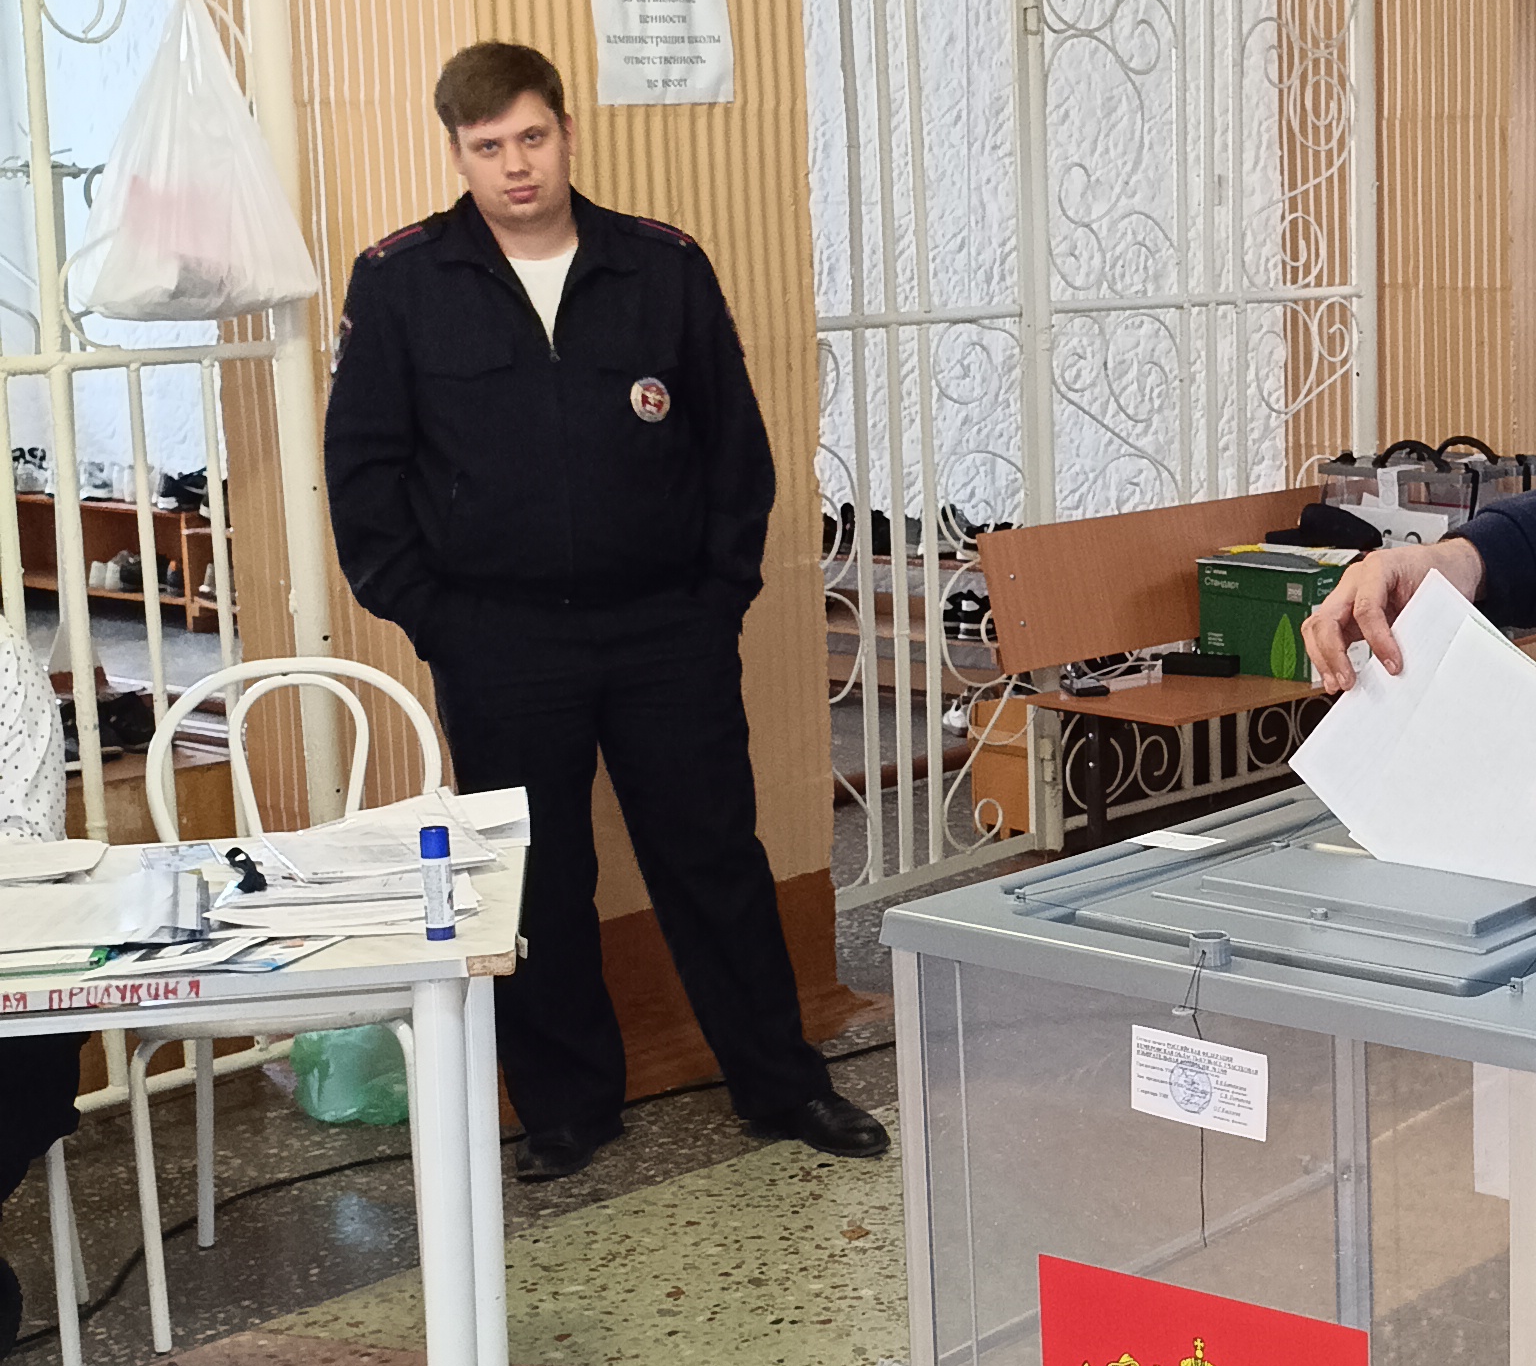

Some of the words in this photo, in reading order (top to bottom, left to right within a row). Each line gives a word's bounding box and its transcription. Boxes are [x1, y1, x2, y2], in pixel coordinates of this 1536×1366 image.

[639, 14, 687, 24] ценности
[606, 35, 685, 47] администрация
[687, 35, 721, 45] школы
[1204, 576, 1240, 590] Стандарт
[48, 979, 201, 1010] ПРОДУКЦИЯ
